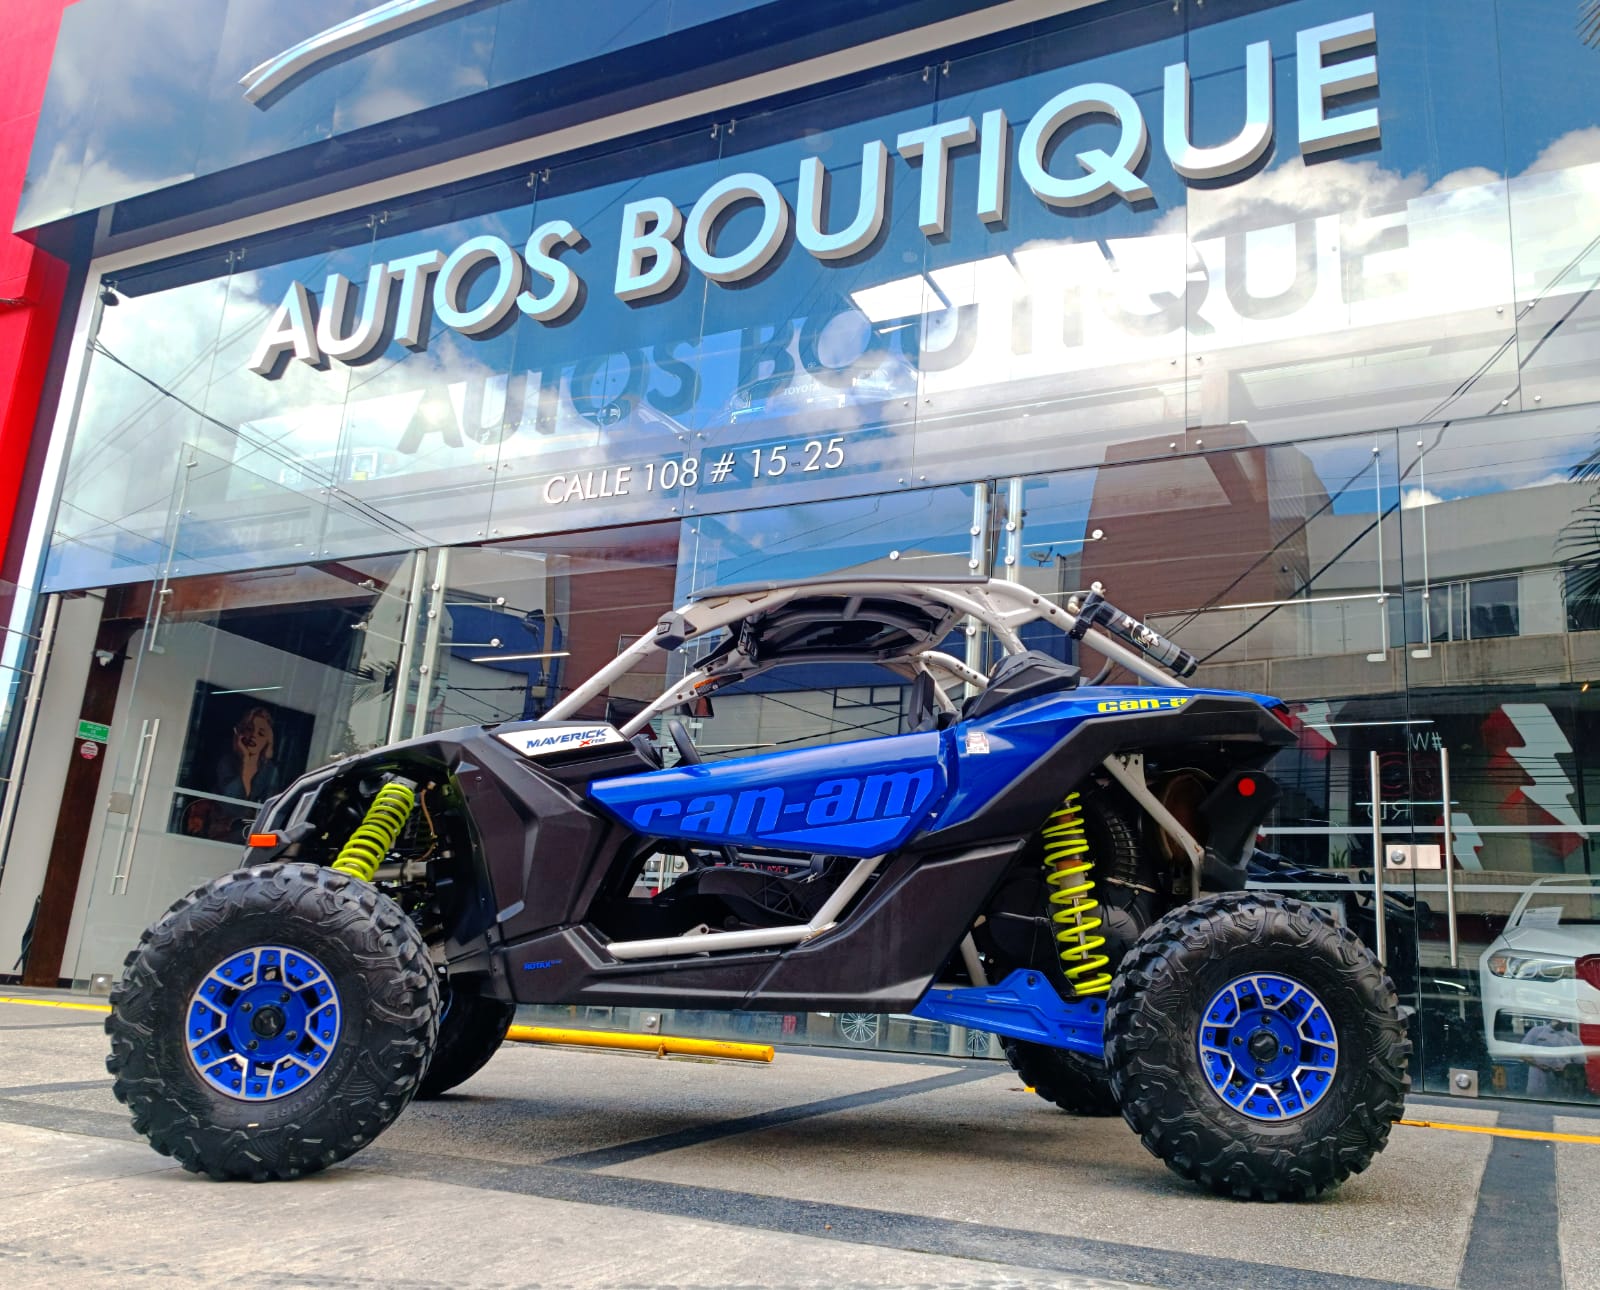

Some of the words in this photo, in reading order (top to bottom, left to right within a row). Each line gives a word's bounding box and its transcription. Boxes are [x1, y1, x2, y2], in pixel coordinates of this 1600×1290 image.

[249, 219, 584, 375] AUTOS
[614, 12, 1381, 302] BOUTIQUE
[784, 383, 820, 396] TOYOTA
[543, 466, 631, 504] CALLE
[645, 457, 699, 492] 108
[710, 451, 735, 483] #
[751, 437, 845, 478] 15-25
[526, 727, 608, 749] MAVERICK
[632, 768, 934, 835] can-am
